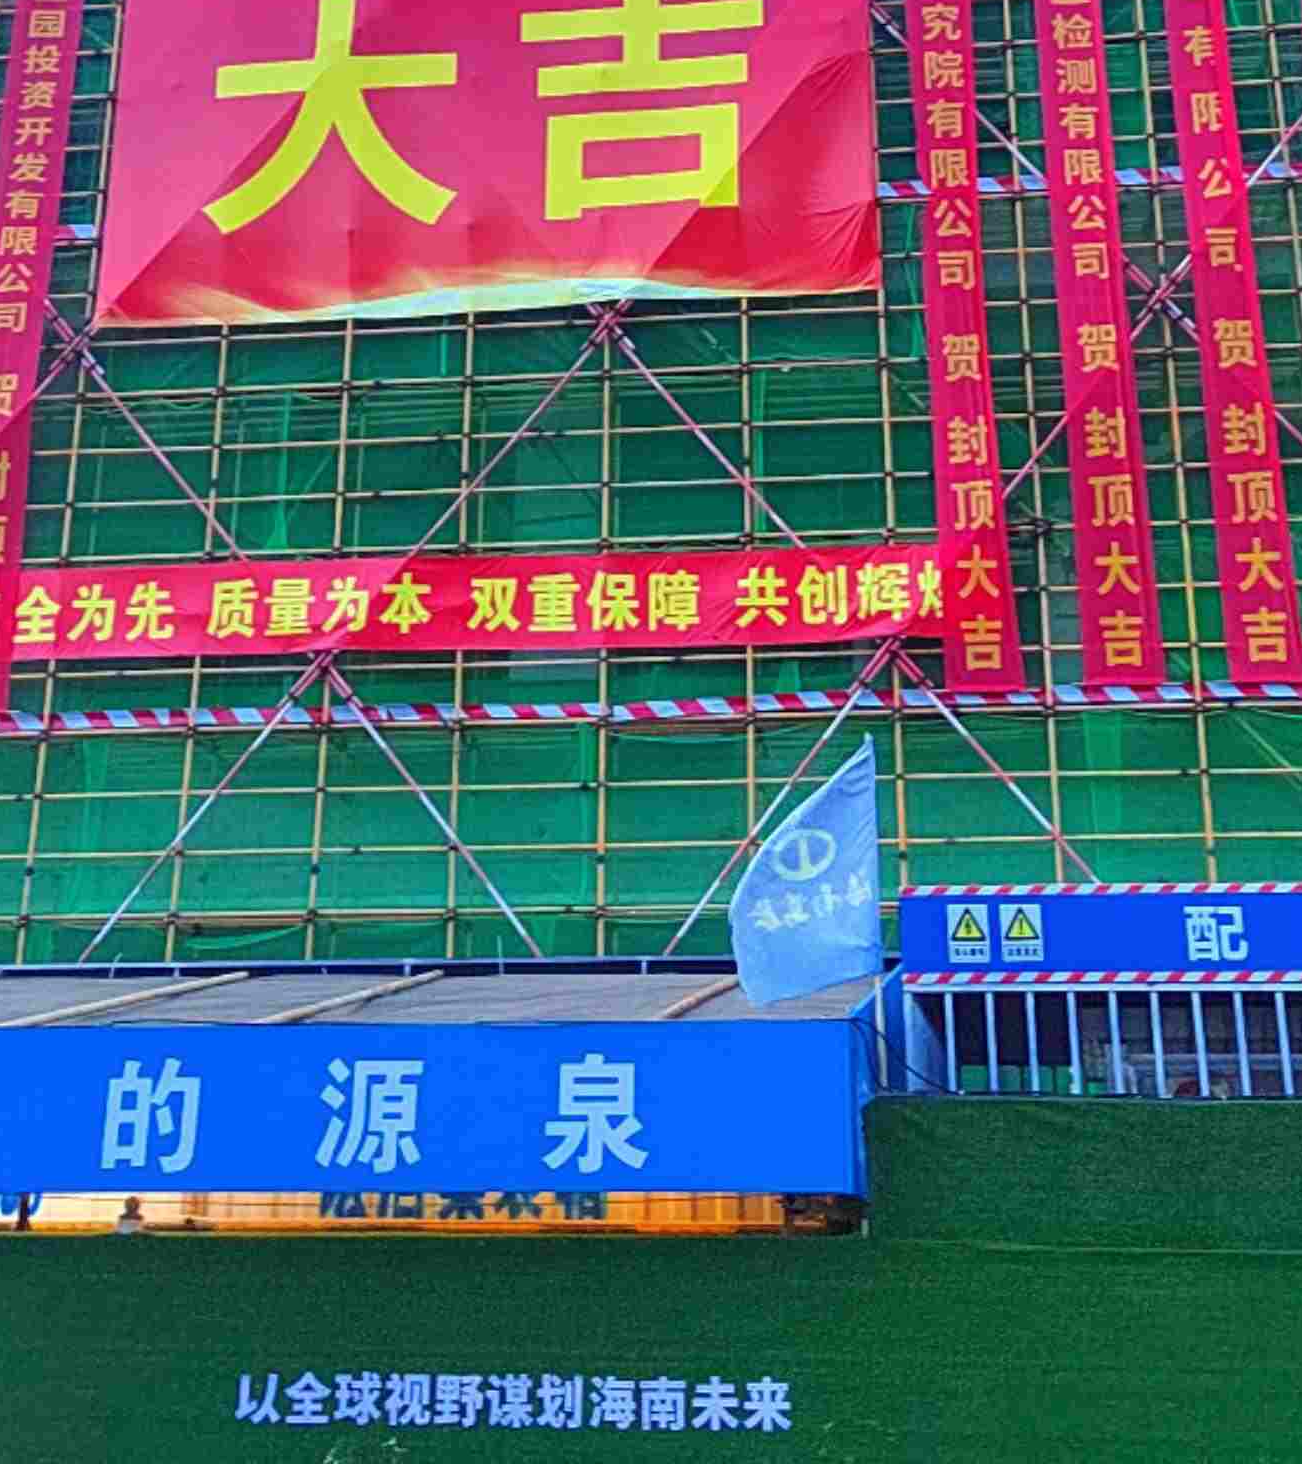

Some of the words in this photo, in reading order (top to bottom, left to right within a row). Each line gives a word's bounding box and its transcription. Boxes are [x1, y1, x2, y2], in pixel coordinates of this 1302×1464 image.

[12, 581, 177, 645] 全为先
[206, 572, 434, 639] 质量为本
[468, 569, 700, 633] 双重保障
[234, 1371, 794, 1432] 以全球视野谋划海南未来
